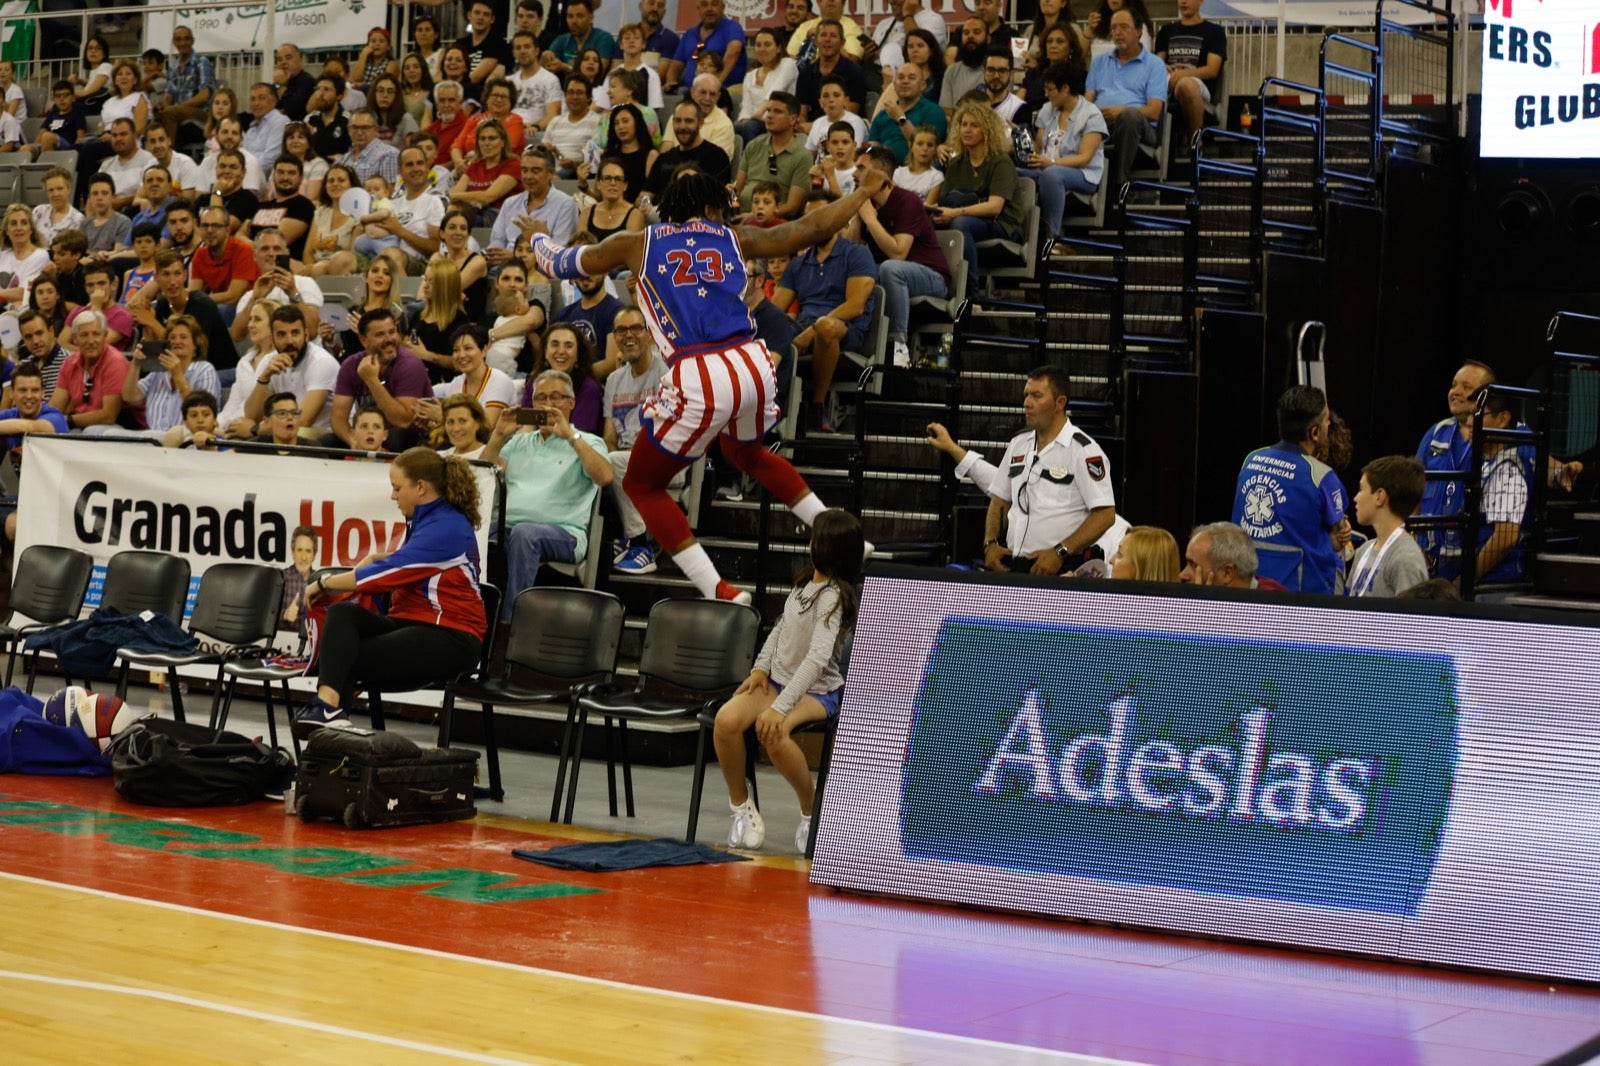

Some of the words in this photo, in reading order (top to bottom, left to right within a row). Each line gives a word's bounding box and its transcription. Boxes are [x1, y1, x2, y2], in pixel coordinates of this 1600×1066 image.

[194, 18, 219, 29] 1990
[284, 11, 327, 27] Mesón
[1484, 23, 1552, 68] ERS
[666, 248, 726, 287] 23
[1246, 462, 1295, 480] AMBULANCIAS
[1252, 455, 1297, 471] ENFERMERO
[1241, 474, 1287, 504] URGENCIAS
[74, 480, 287, 563] Granada
[973, 684, 1373, 831] Adeslas
